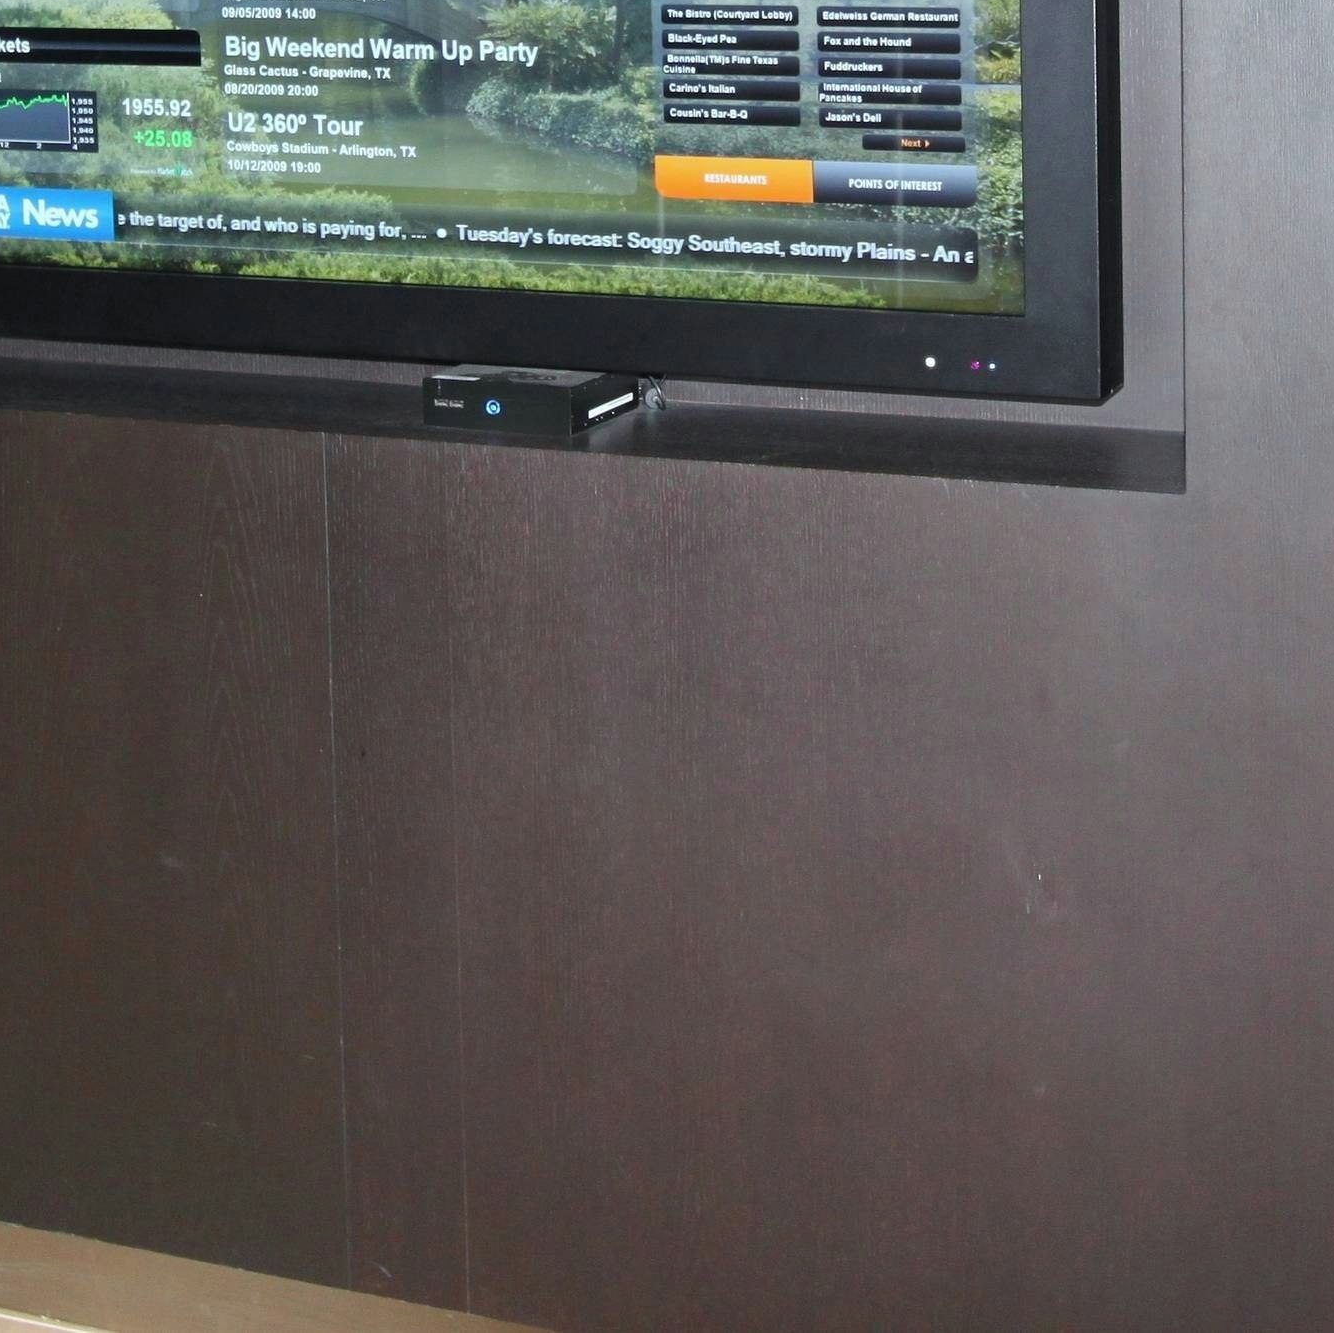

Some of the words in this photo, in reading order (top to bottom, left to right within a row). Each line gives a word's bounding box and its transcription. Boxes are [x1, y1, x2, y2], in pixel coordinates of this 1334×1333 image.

[285, 7, 316, 20] 14:00
[685, 9, 711, 18] Bistro
[762, 11, 793, 21] Lobby)
[907, 12, 958, 22] Restaurant
[668, 33, 718, 45] Black-Eyed
[823, 36, 841, 46] Fox
[843, 36, 861, 46] and
[880, 37, 912, 47] Hound
[225, 36, 260, 61] Big
[266, 37, 364, 59] Weekend
[370, 38, 434, 60] Warm
[442, 39, 472, 66] Up
[479, 40, 538, 67] Party
[224, 64, 256, 77] Glass
[259, 65, 299, 77] Cactus
[309, 66, 372, 80] Grapevine,
[375, 67, 391, 79] TX
[824, 61, 883, 72] Fuddruckers
[287, 84, 319, 97] 20:00
[823, 83, 880, 92] International
[882, 84, 911, 93] House
[819, 93, 862, 103] Pancakes
[122, 97, 192, 117] 1955.92
[670, 108, 709, 118] Cousin's
[825, 112, 861, 122] Jason's
[228, 112, 256, 133] U2
[313, 114, 363, 136] Tour
[134, 129, 193, 148] +25.08
[901, 139, 921, 148] Next
[227, 140, 279, 154] Cowboys
[282, 142, 328, 155] Stadium
[339, 144, 396, 159] Arlington,
[400, 146, 416, 158] TX
[228, 159, 287, 172] 10/12/2009
[290, 161, 321, 173] 19:00
[704, 173, 767, 185] RESTAURANTS
[848, 178, 883, 190] POINTS
[901, 180, 942, 192] INTEREST
[22, 197, 99, 228] News
[129, 211, 154, 226] the
[158, 213, 204, 232] target
[207, 214, 227, 232] of,
[231, 216, 261, 232] and
[264, 217, 298, 233] who
[302, 218, 316, 233] is
[320, 220, 375, 241] paying
[379, 221, 407, 240] for,
[456, 225, 543, 248] Tuesday's
[547, 229, 623, 248] forecast:
[627, 232, 684, 255] Soggy
[688, 234, 786, 258] Southeast,
[790, 242, 853, 262] stormy
[857, 242, 916, 262] Plains
[933, 245, 960, 264] An
